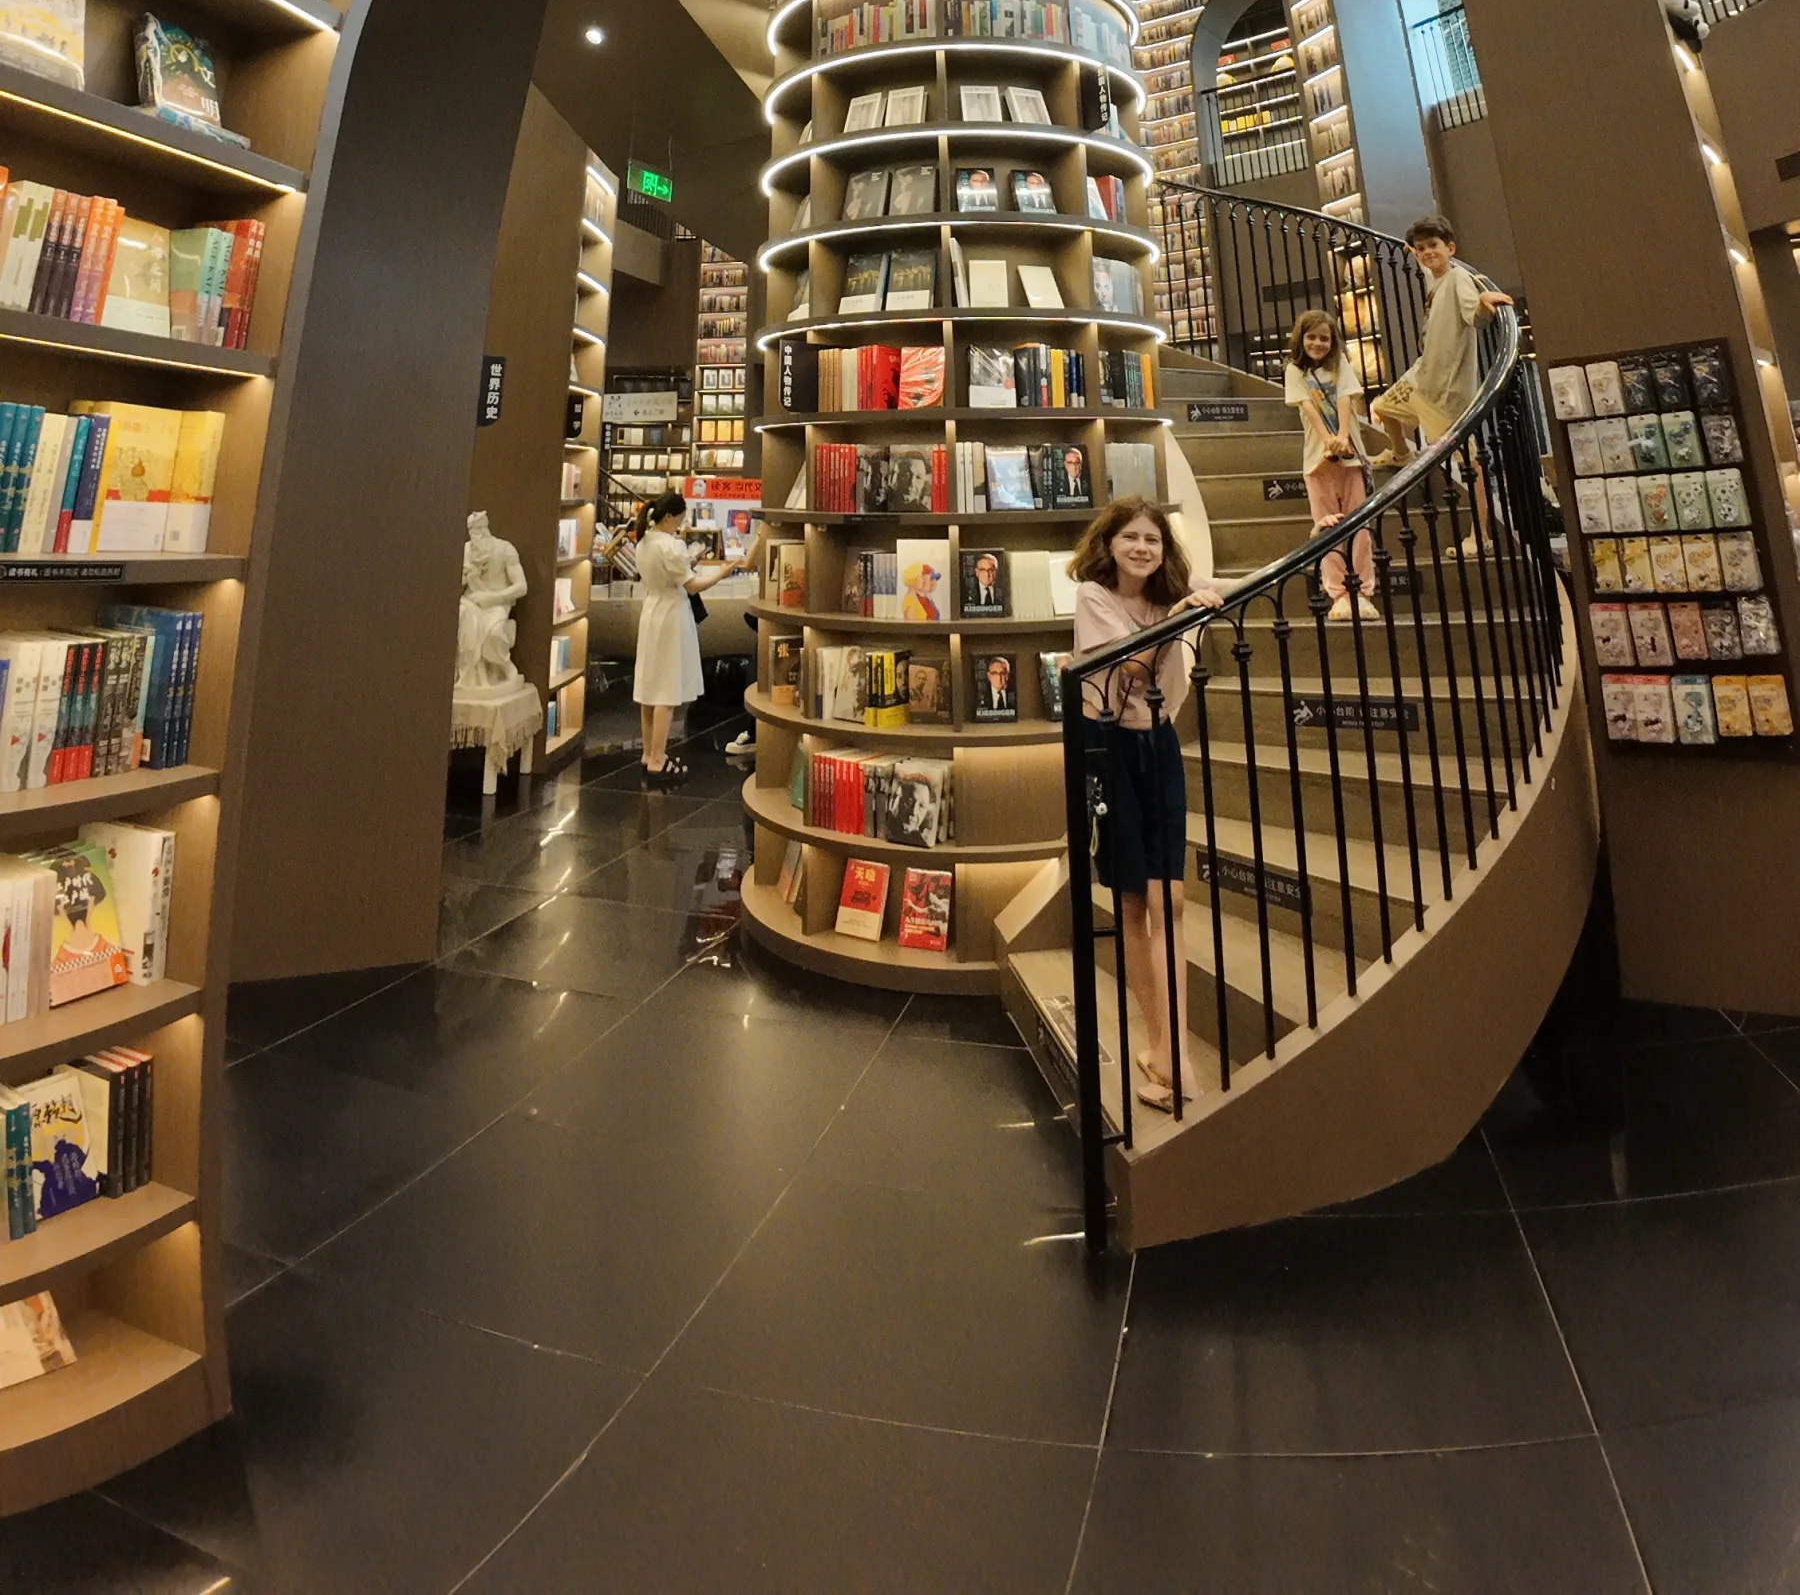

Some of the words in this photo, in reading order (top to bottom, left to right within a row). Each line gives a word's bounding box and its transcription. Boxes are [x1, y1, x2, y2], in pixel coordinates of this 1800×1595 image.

[783, 344, 793, 407] 中国人物传记
[485, 363, 503, 420] 世界历史
[1284, 482, 1305, 491] 小心台
[964, 604, 1003, 612] KISSINGER
[976, 708, 1016, 717] KISSINGER
[1316, 705, 1355, 717] 小台阶
[1221, 864, 1256, 884] 小心台阶
